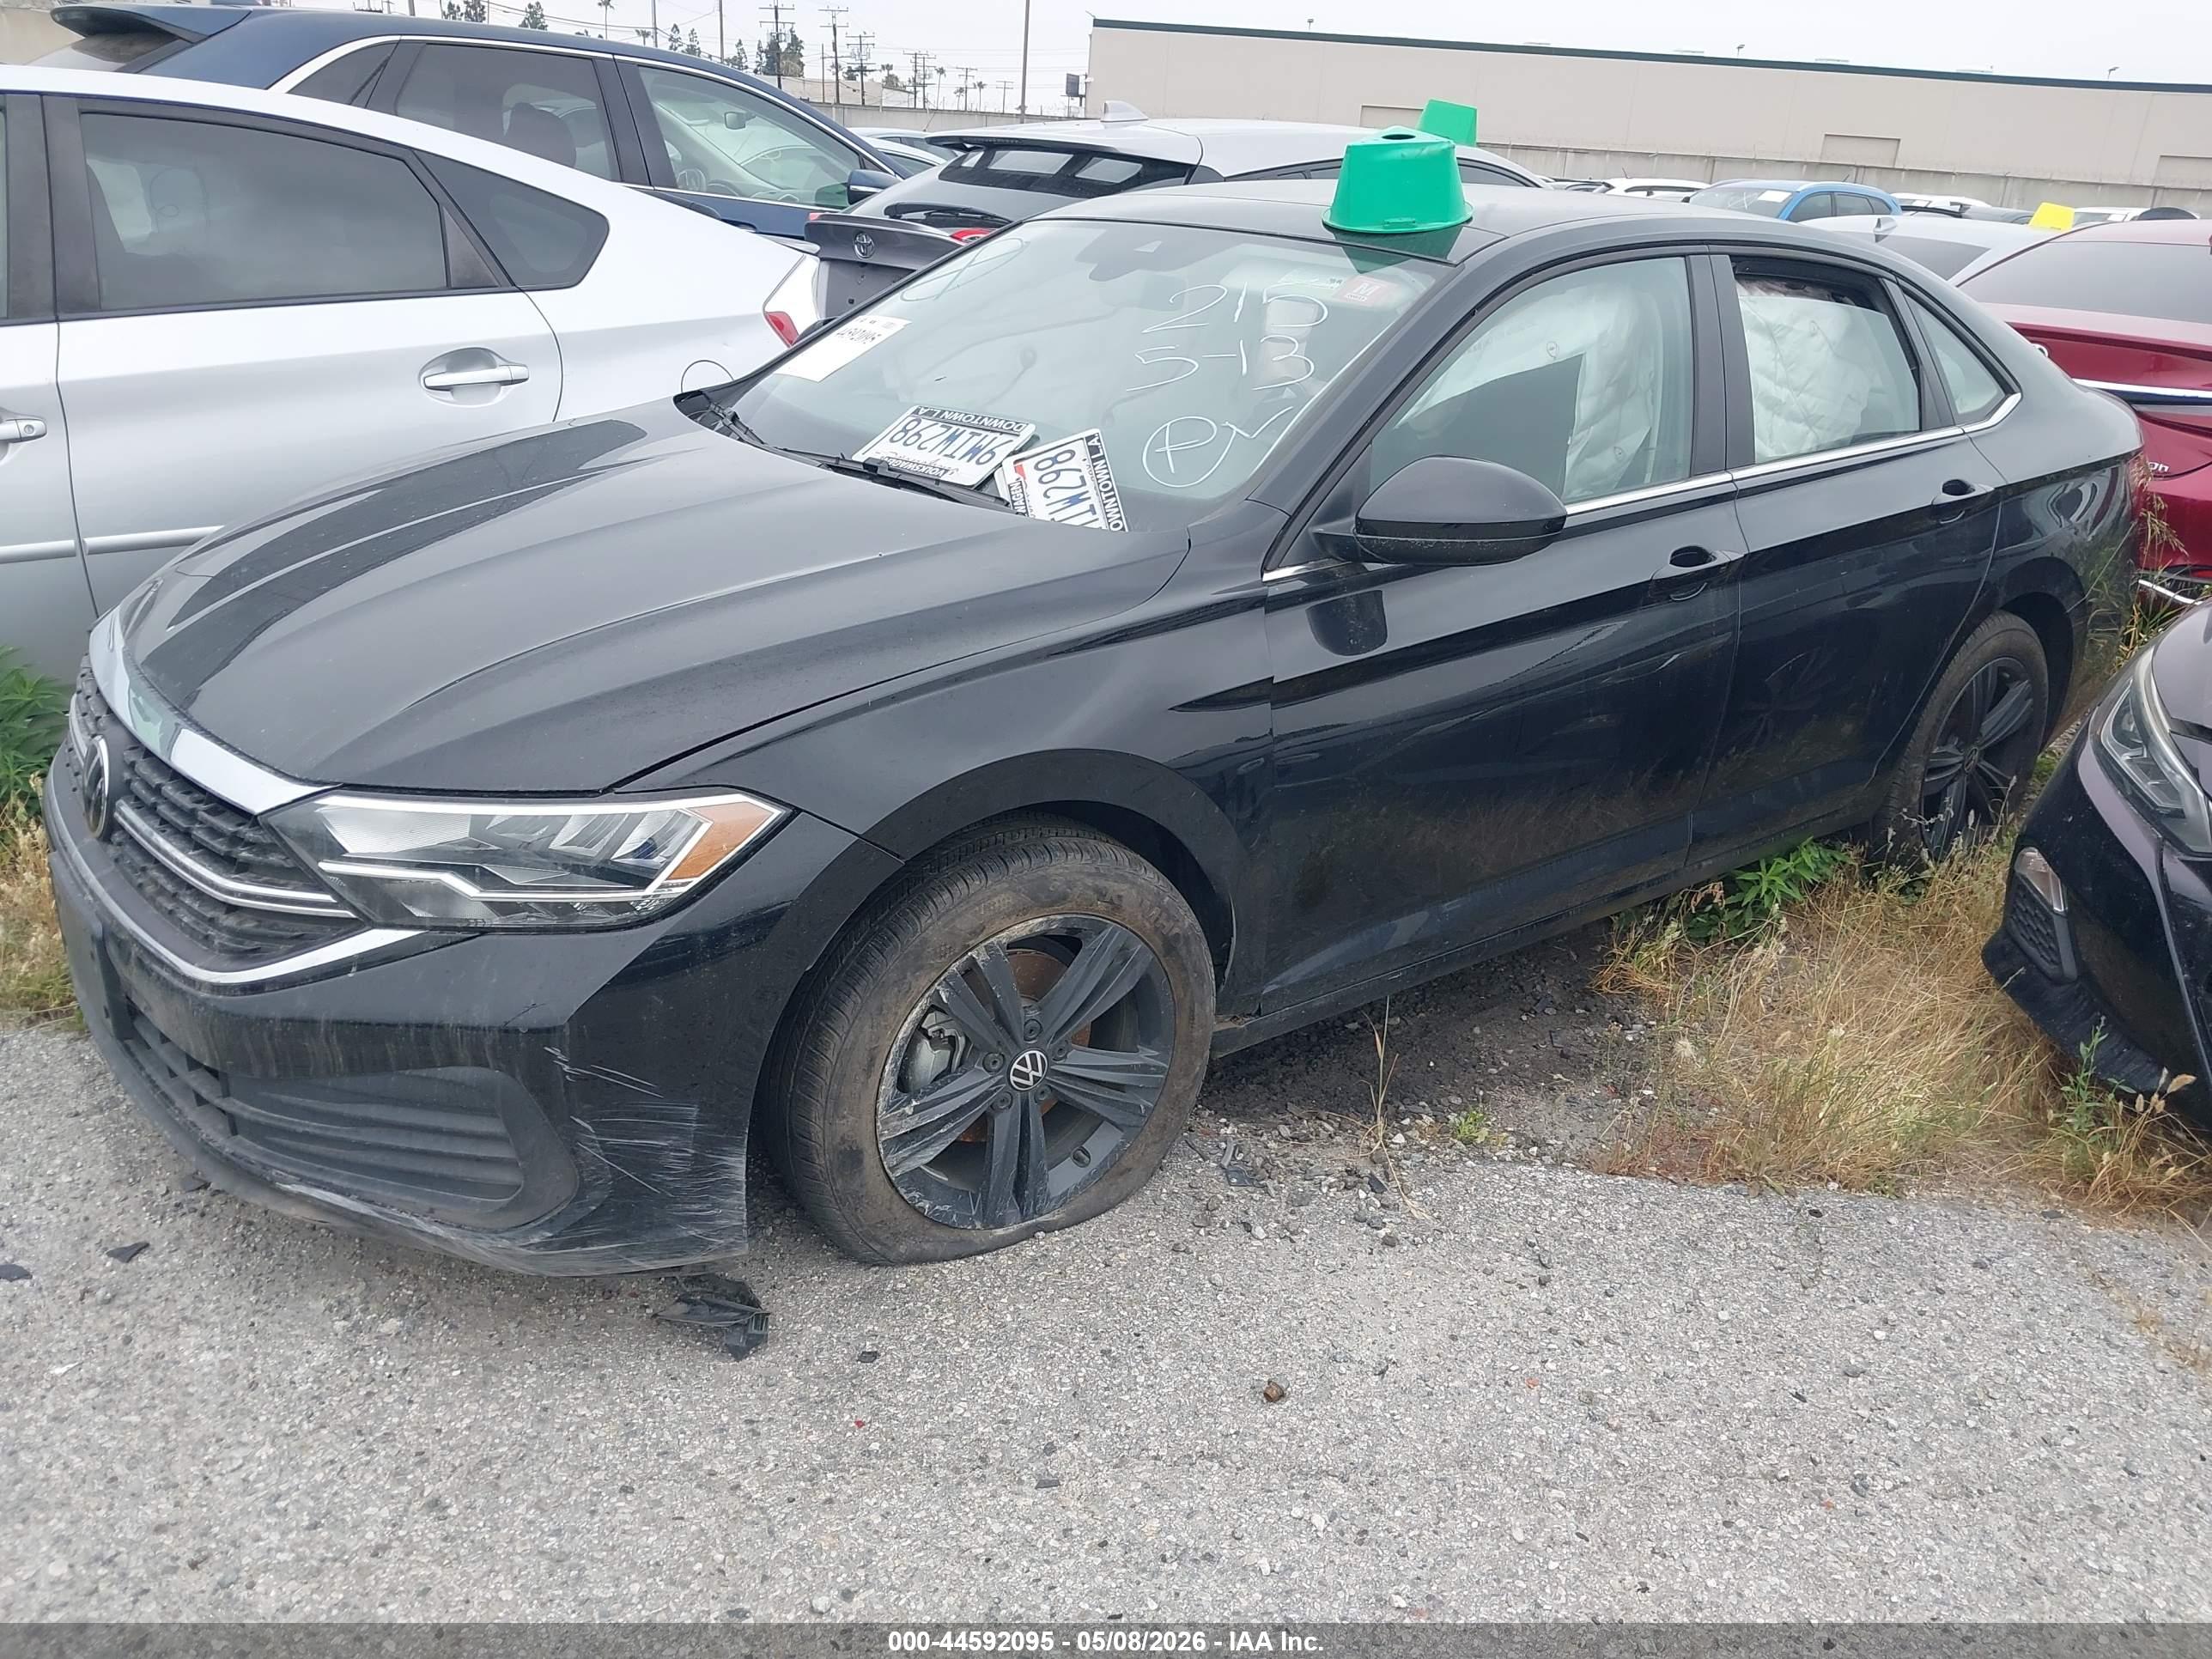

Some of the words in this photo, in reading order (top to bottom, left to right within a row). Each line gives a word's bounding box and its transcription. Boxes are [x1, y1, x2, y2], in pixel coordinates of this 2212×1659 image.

[939, 411, 1027, 433] DOWNTOWN
[1033, 449, 1100, 526] IW298
[1091, 459, 1124, 532] OWNTOWN
